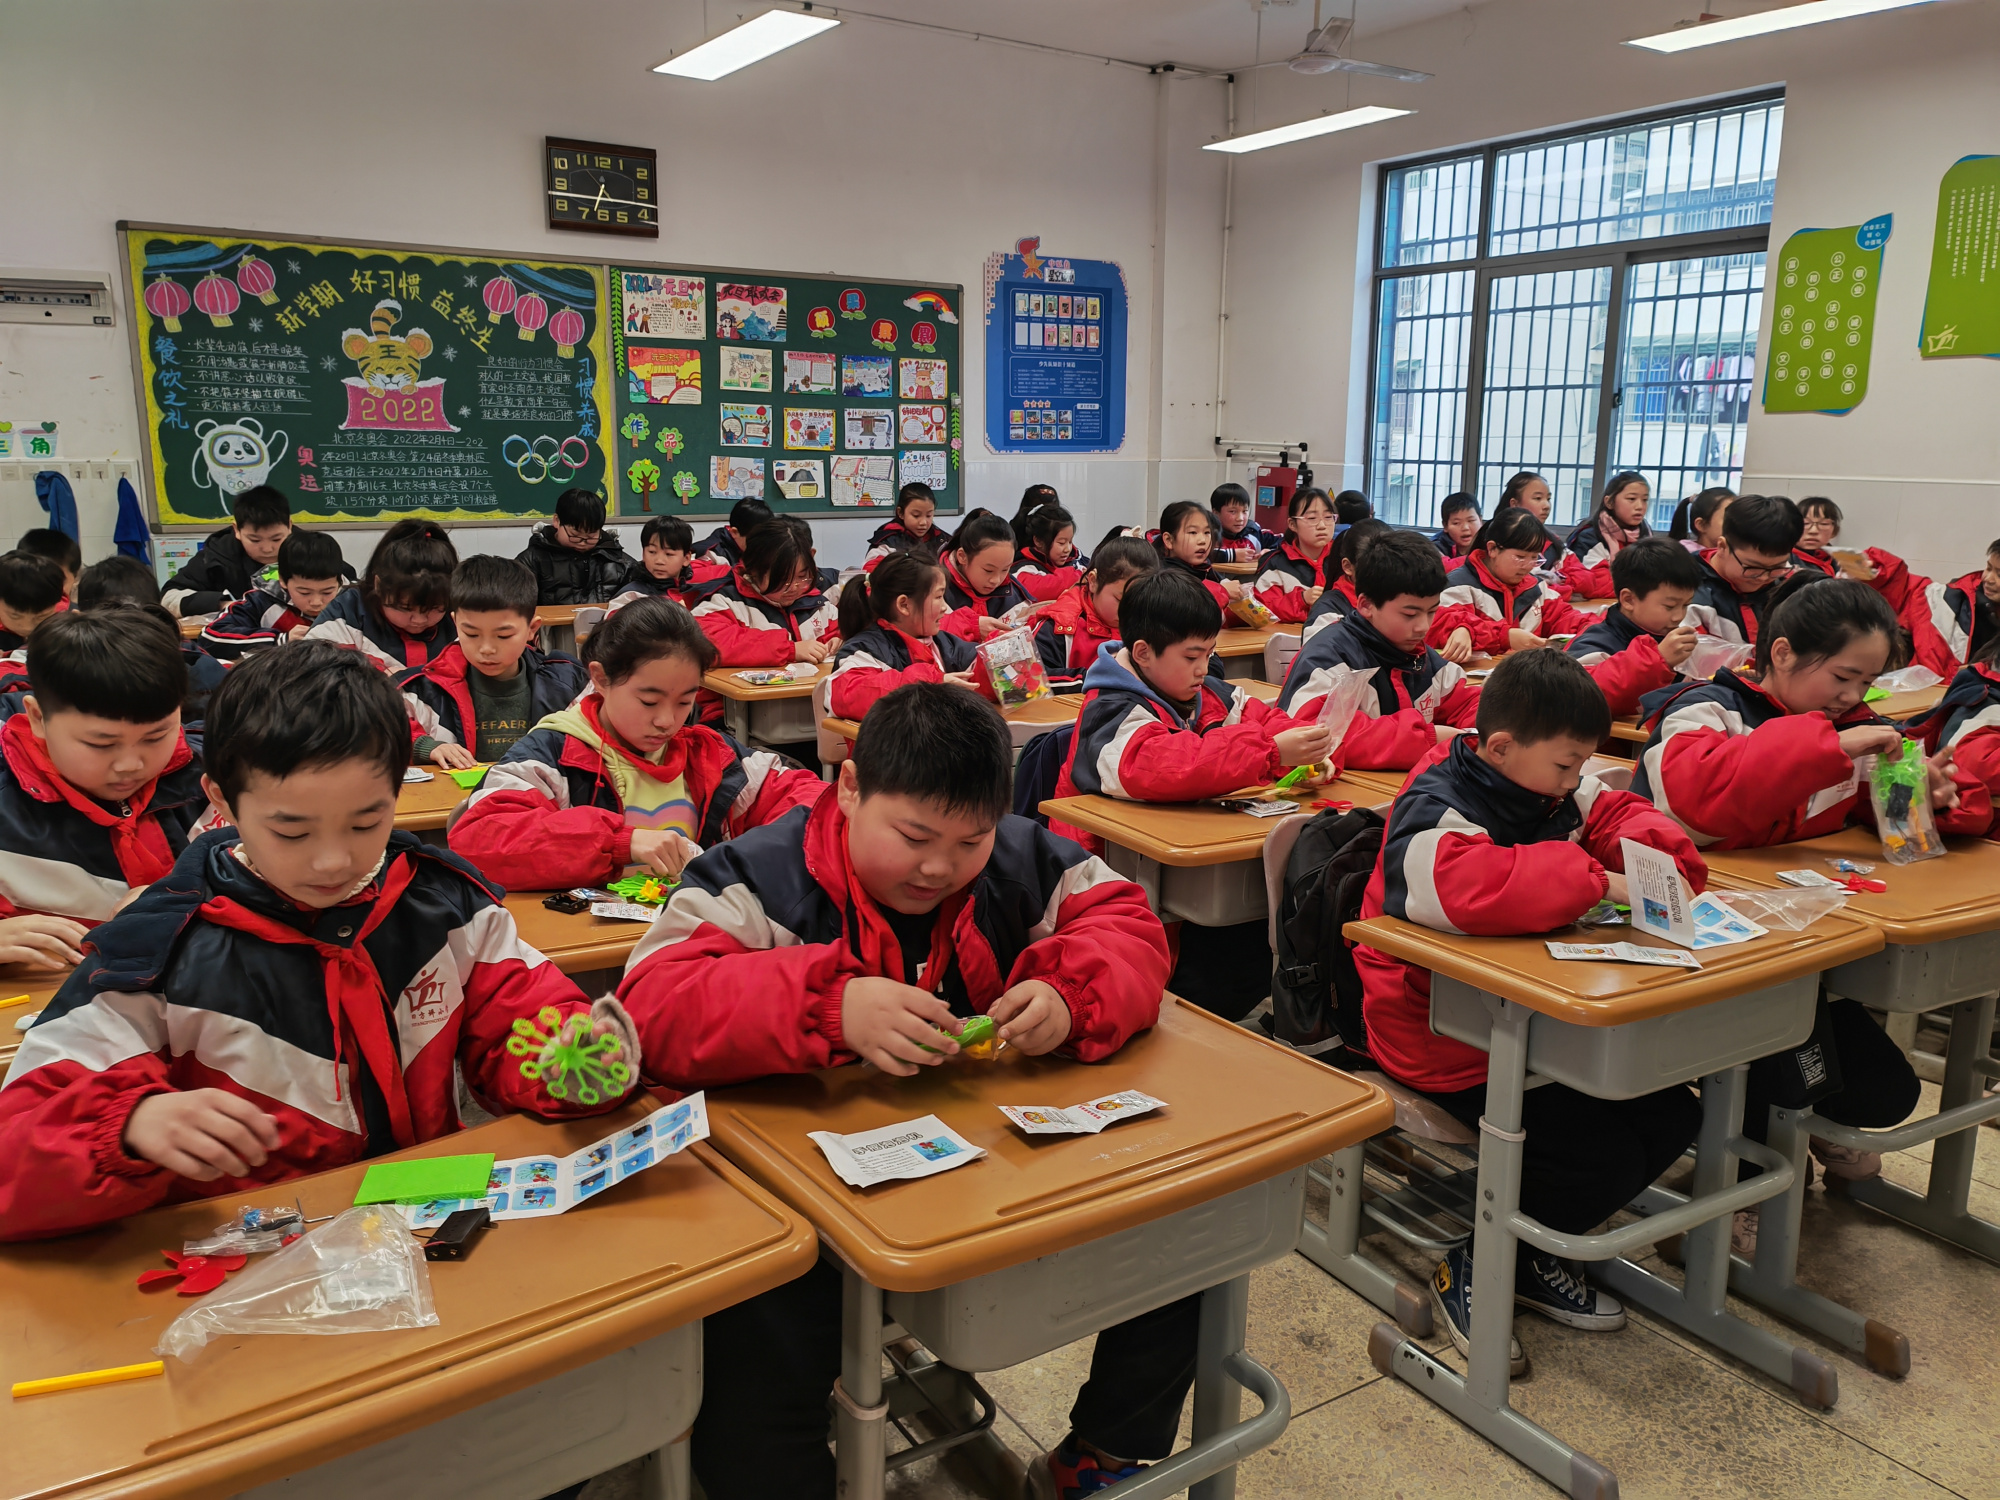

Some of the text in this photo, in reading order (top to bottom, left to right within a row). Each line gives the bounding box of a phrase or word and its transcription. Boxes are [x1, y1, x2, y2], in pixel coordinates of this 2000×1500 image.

[554, 157, 568, 170] 10
[576, 153, 588, 166] 11
[594, 156, 611, 169] 12
[618, 159, 624, 171] 1
[636, 168, 648, 180] 2
[555, 177, 568, 191] 9
[637, 187, 648, 199] 3
[556, 199, 568, 211] 8
[578, 206, 590, 220] 7
[597, 209, 609, 222] 6
[616, 211, 628, 223] 5
[637, 208, 649, 220] 4
[275, 269, 494, 354] 新学期 好习惯 益终生
[154, 336, 190, 430] 餐饮之礼
[575, 358, 597, 438] 习惯养成
[361, 397, 434, 423] 2022
[630, 418, 644, 433] 作
[30, 436, 50, 455] 角
[333, 431, 388, 446] 北京冬奥会
[663, 433, 677, 449] 品
[297, 446, 322, 492] 奥运
